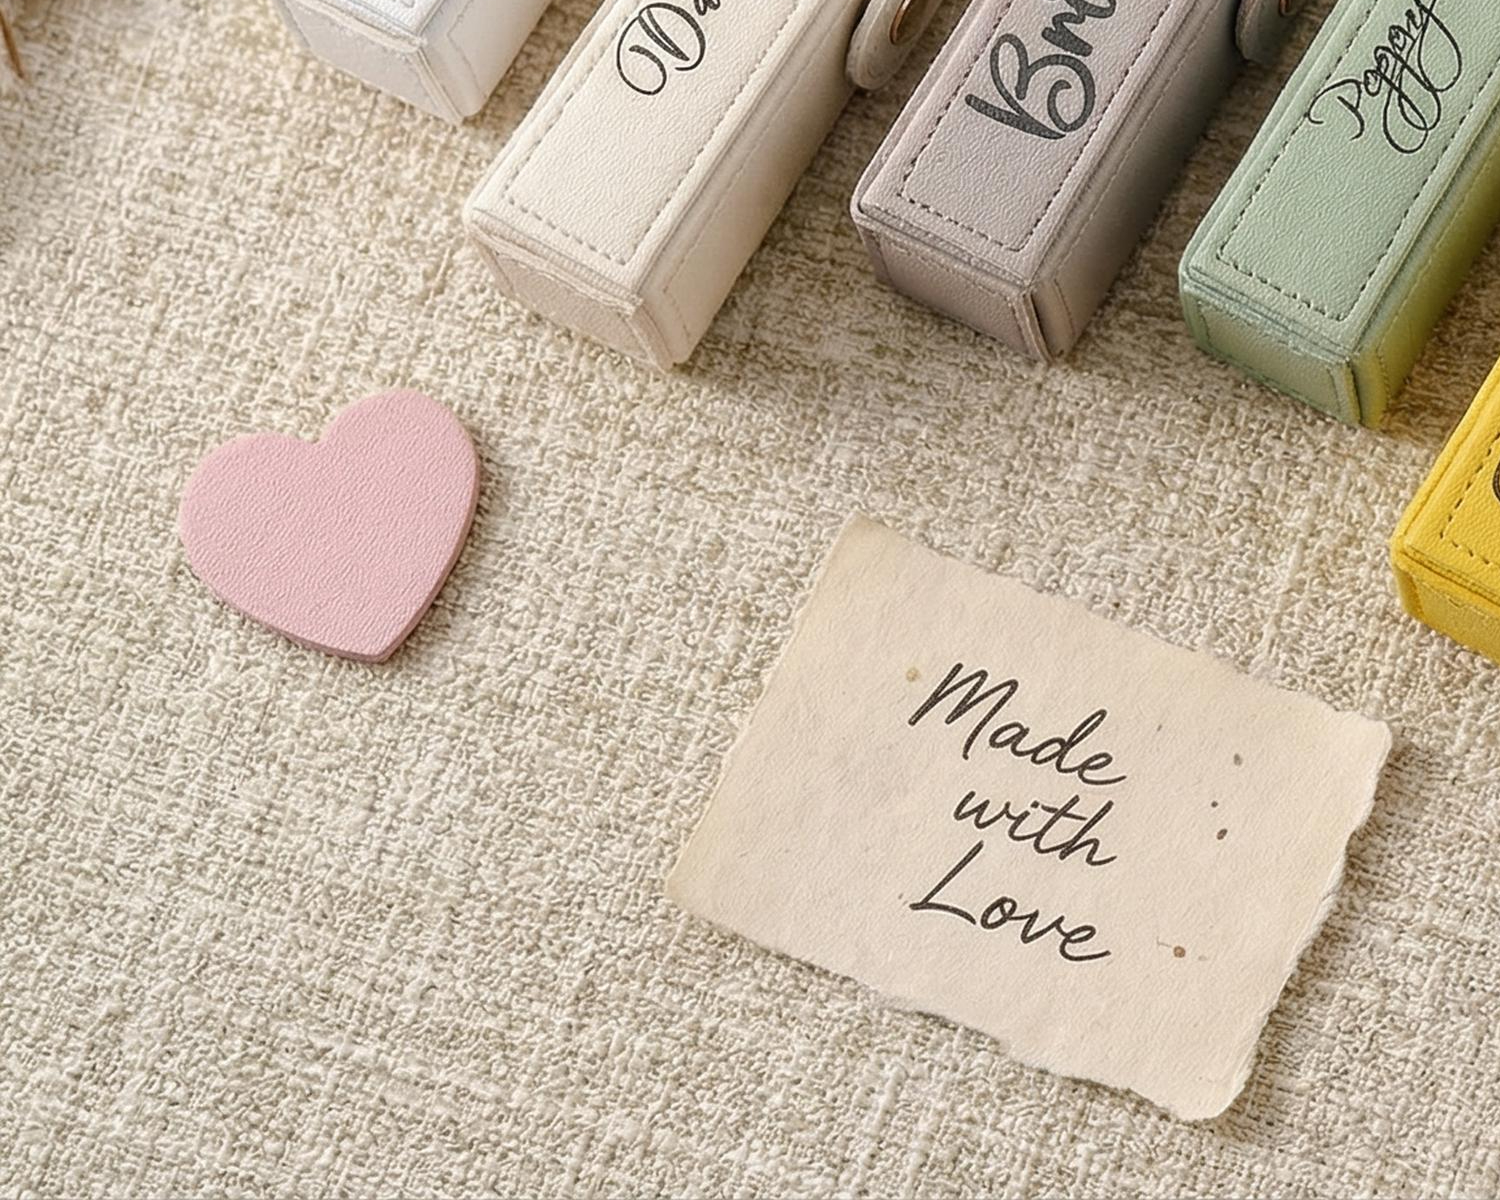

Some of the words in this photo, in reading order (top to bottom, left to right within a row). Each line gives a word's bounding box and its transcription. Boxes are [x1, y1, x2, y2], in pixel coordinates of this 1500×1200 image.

[907, 662, 1127, 787] Made
[953, 785, 1118, 867] with
[909, 841, 1112, 964] Love
